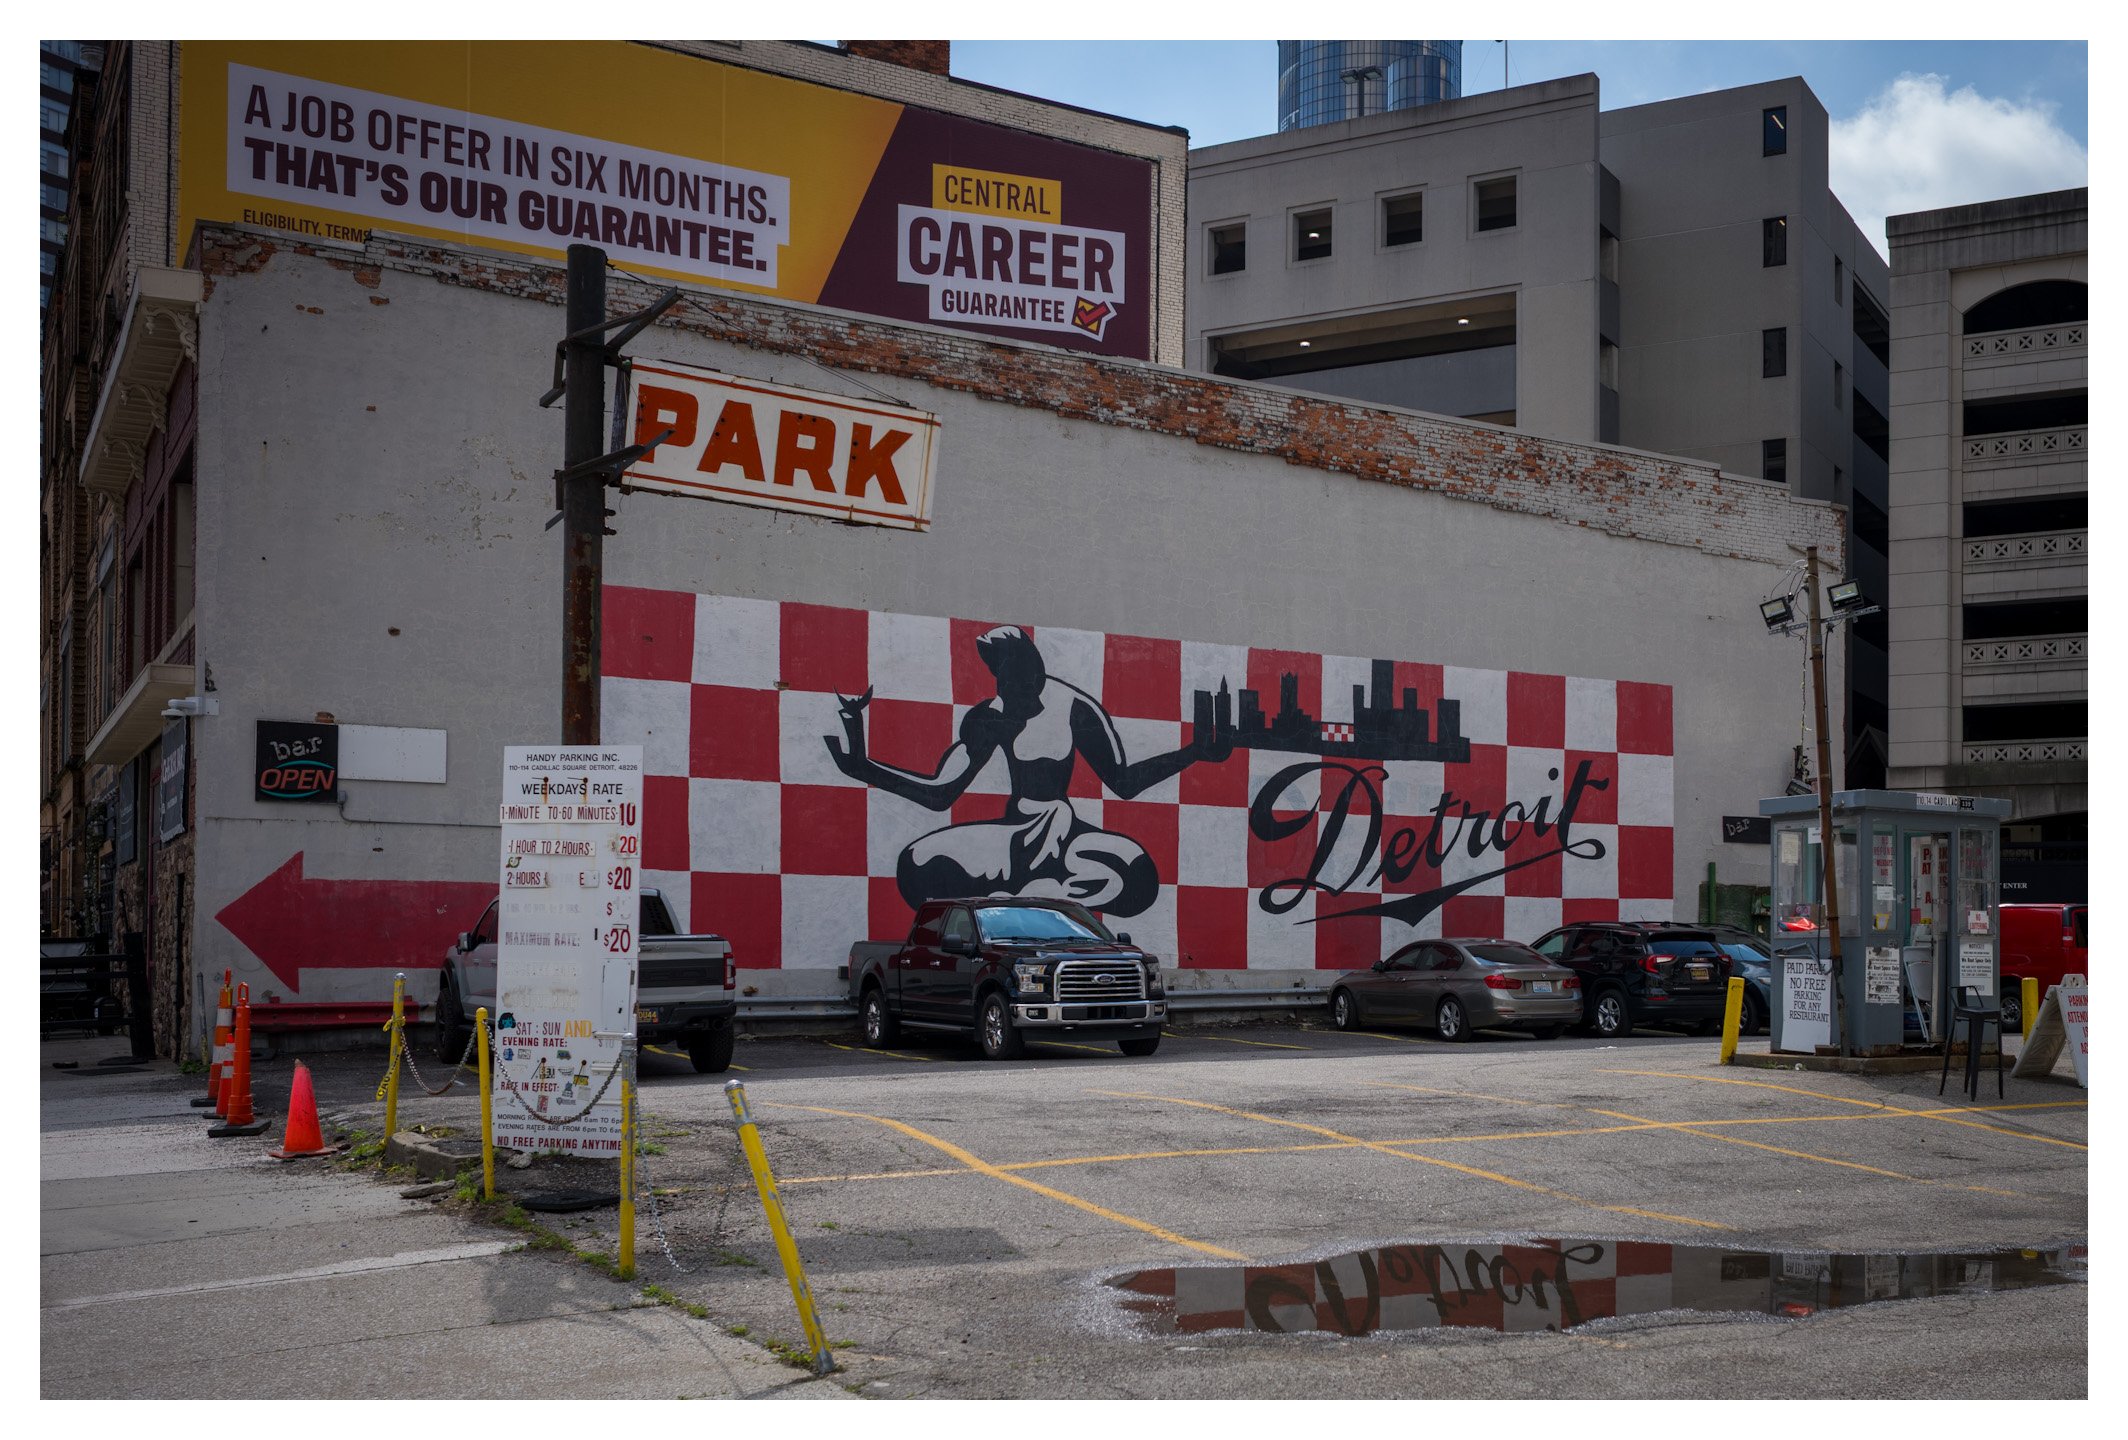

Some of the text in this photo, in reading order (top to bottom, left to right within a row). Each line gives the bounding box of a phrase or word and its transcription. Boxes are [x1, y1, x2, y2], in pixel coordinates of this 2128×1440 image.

[244, 84, 776, 226] A JOB OFFER IN SIX MONTHS.
[244, 136, 767, 272] THAT'S OUR GUARANTEE.
[945, 175, 1051, 215] CENTRAL
[909, 216, 1114, 293] CAREER
[941, 288, 1065, 323] GUARANTEE
[634, 383, 913, 505] PARK
[269, 736, 324, 761] bar
[526, 753, 620, 762] HANDY PARKING INC.
[259, 768, 336, 791] OPEN
[521, 783, 623, 795] WEEKDAYS RATE
[619, 802, 636, 826] 10
[1248, 758, 1611, 916] Detroit
[1726, 818, 1750, 837] bar
[516, 840, 537, 853] HOUR
[541, 841, 552, 854] TO
[555, 841, 561, 854] 2
[561, 841, 590, 856] HOURS
[515, 872, 541, 885] HOURS
[607, 866, 632, 890] $20
[604, 928, 631, 953] $20
[1786, 962, 1804, 974] PAID
[1790, 977, 1826, 991] NO FREE
[1793, 990, 1822, 1001] PARKING
[1793, 1000, 1822, 1012] FOR ANY
[1789, 1010, 1829, 1023] RESTAURANT
[515, 1022, 532, 1036] SAT
[542, 1022, 561, 1036] SUN
[564, 1019, 592, 1038] AND
[502, 1036, 568, 1048] EVENING RATE:
[521, 1082, 529, 1092] IN
[497, 1113, 526, 1121] MORNING
[497, 1135, 622, 1151] NO FREE PARKING ANYTIME
